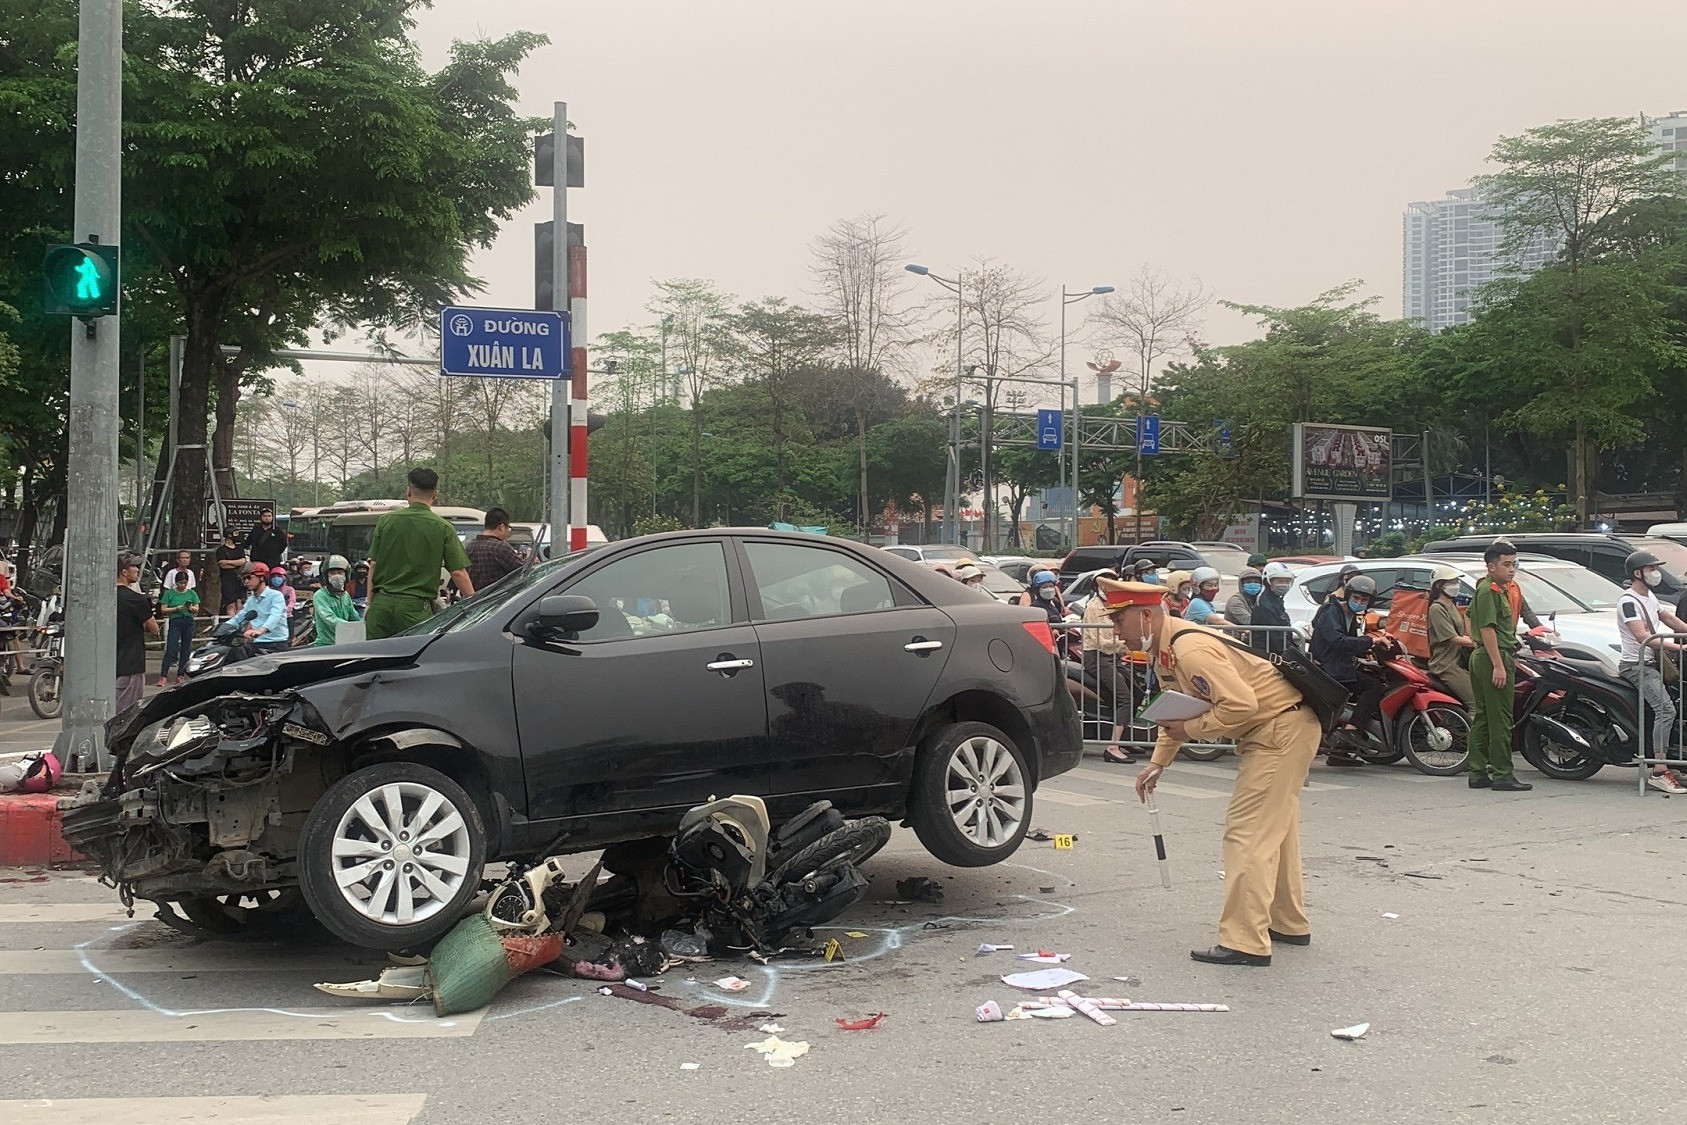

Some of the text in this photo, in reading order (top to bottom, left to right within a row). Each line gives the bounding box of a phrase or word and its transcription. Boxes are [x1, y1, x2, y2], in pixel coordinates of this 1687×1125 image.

[484, 317, 550, 336] ĐƯỜNG
[467, 340, 544, 370] XUÂN LA
[1058, 837, 1070, 847] 16
